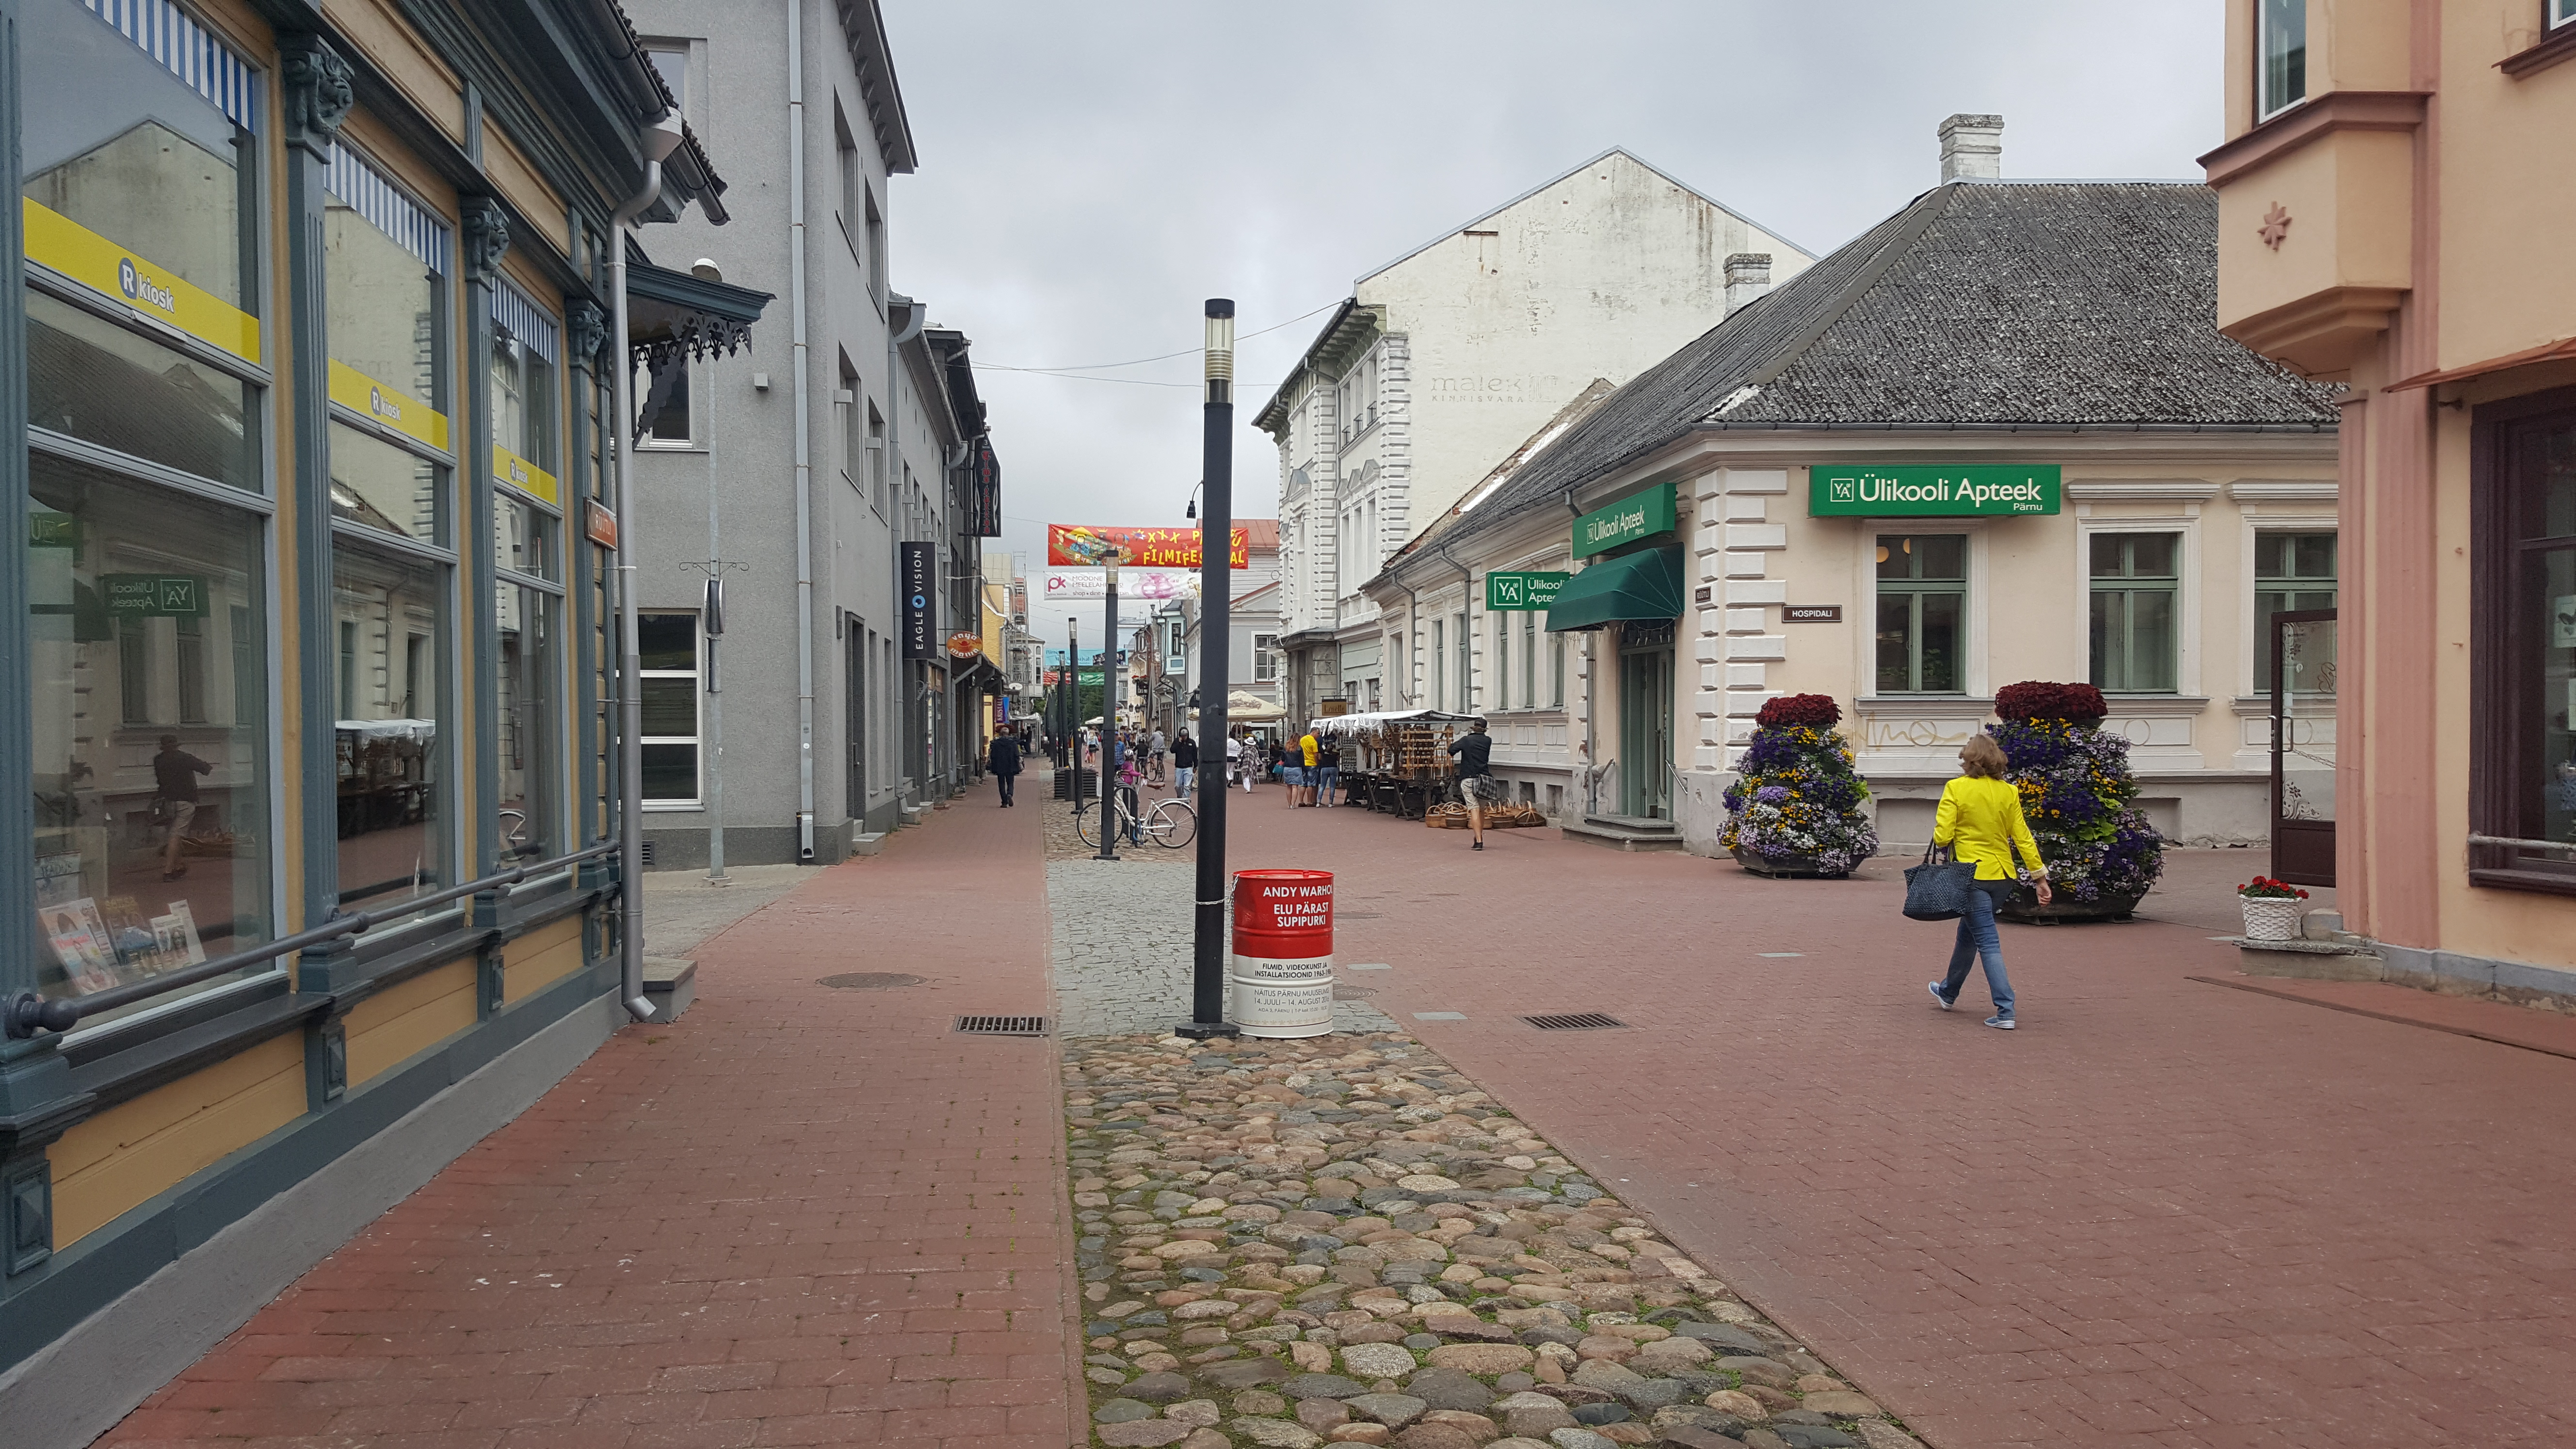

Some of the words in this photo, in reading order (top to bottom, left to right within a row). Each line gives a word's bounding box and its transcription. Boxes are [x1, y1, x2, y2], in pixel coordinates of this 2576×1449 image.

[122, 264, 135, 293] R
[138, 272, 175, 314] kiosk
[372, 391, 380, 412] R
[381, 395, 401, 421] kiosk
[1860, 473, 1948, 501] Ülikooli
[1954, 478, 2043, 508] Apteek
[2013, 502, 2043, 511] Pärnu
[1594, 517, 1619, 541] Ülikooli
[1619, 504, 1645, 537] Apteek
[914, 550, 922, 593] VISION
[1528, 577, 1565, 590] Ülikool
[915, 611, 924, 650] EAGLE
[1263, 886, 1297, 897] ANDY
[1274, 904, 1293, 915] ELU
[1296, 901, 1329, 915] PÄRAST
[1277, 915, 1326, 927] SUPIPURKI
[1262, 963, 1284, 971] FILMID,
[1255, 970, 1313, 978] INSTALLATSIOONID
[1254, 988, 1276, 997] NÄITUS
[1298, 997, 1320, 1005] AUGUST
